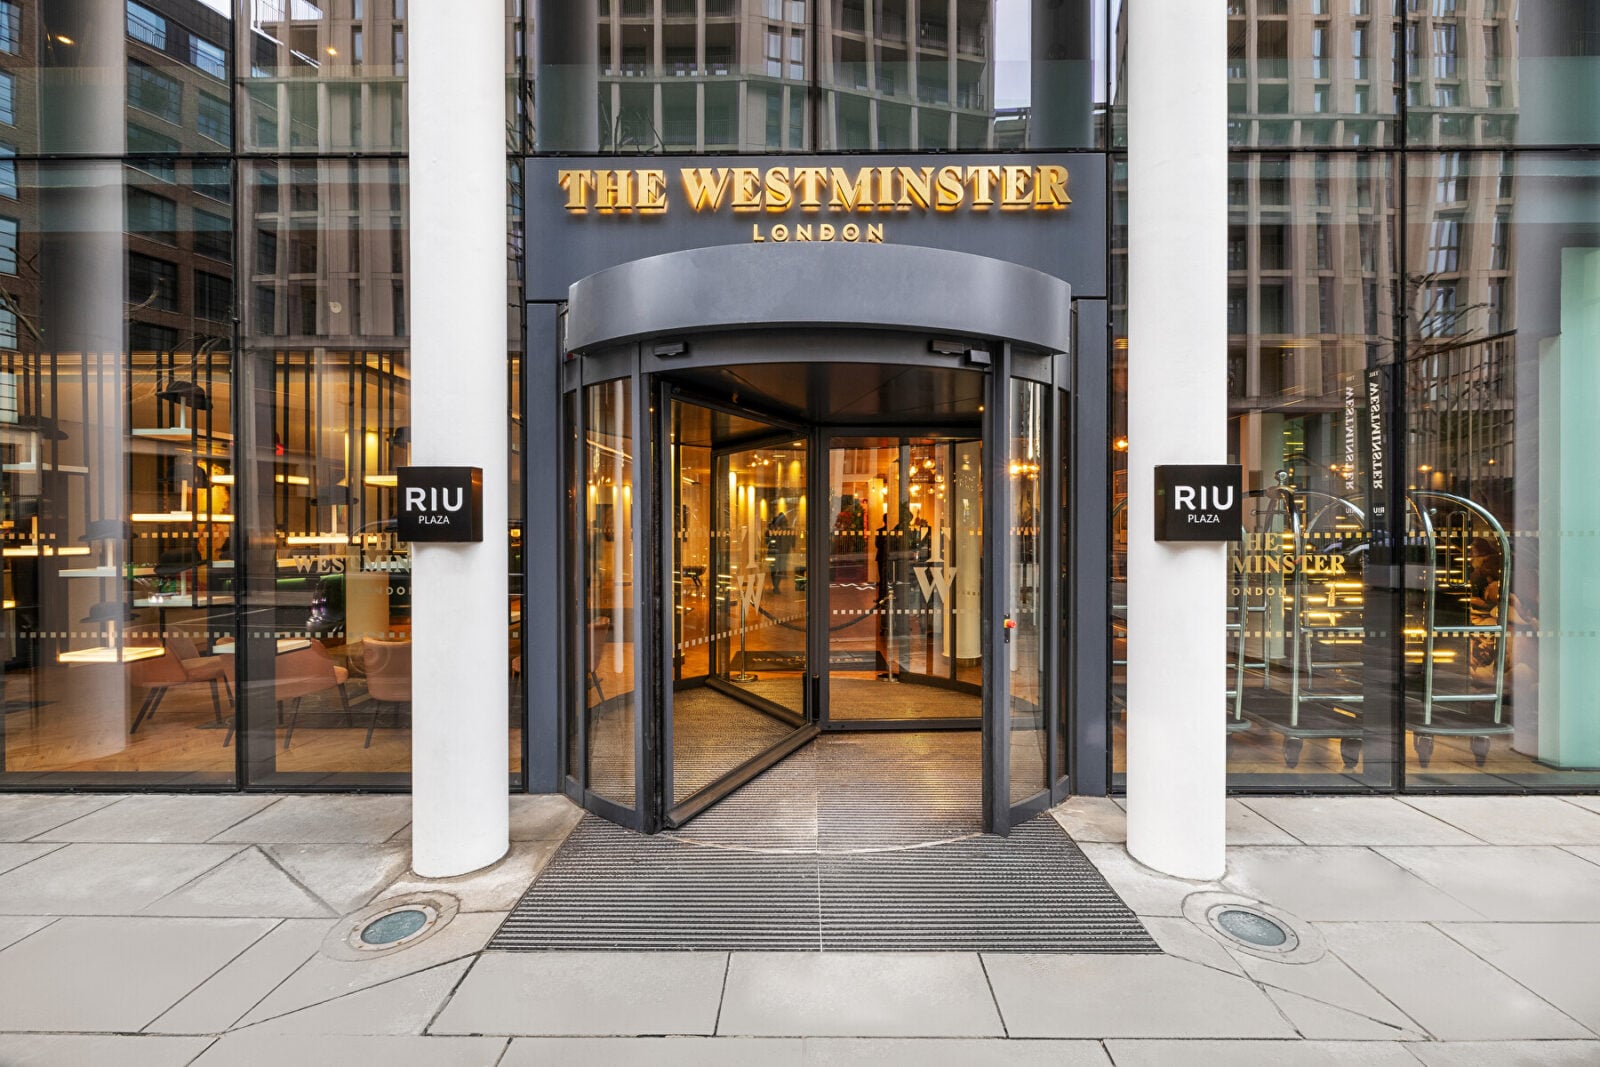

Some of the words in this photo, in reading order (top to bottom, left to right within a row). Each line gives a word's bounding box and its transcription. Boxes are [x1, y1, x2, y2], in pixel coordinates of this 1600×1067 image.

[557, 168, 667, 213] THE
[680, 165, 1073, 213] WESTMINSTER
[753, 223, 884, 242] LONDON
[406, 487, 463, 511] RIU
[1174, 485, 1234, 510] RIU
[418, 515, 450, 525] PLAZA
[1187, 514, 1220, 523] PLAZA
